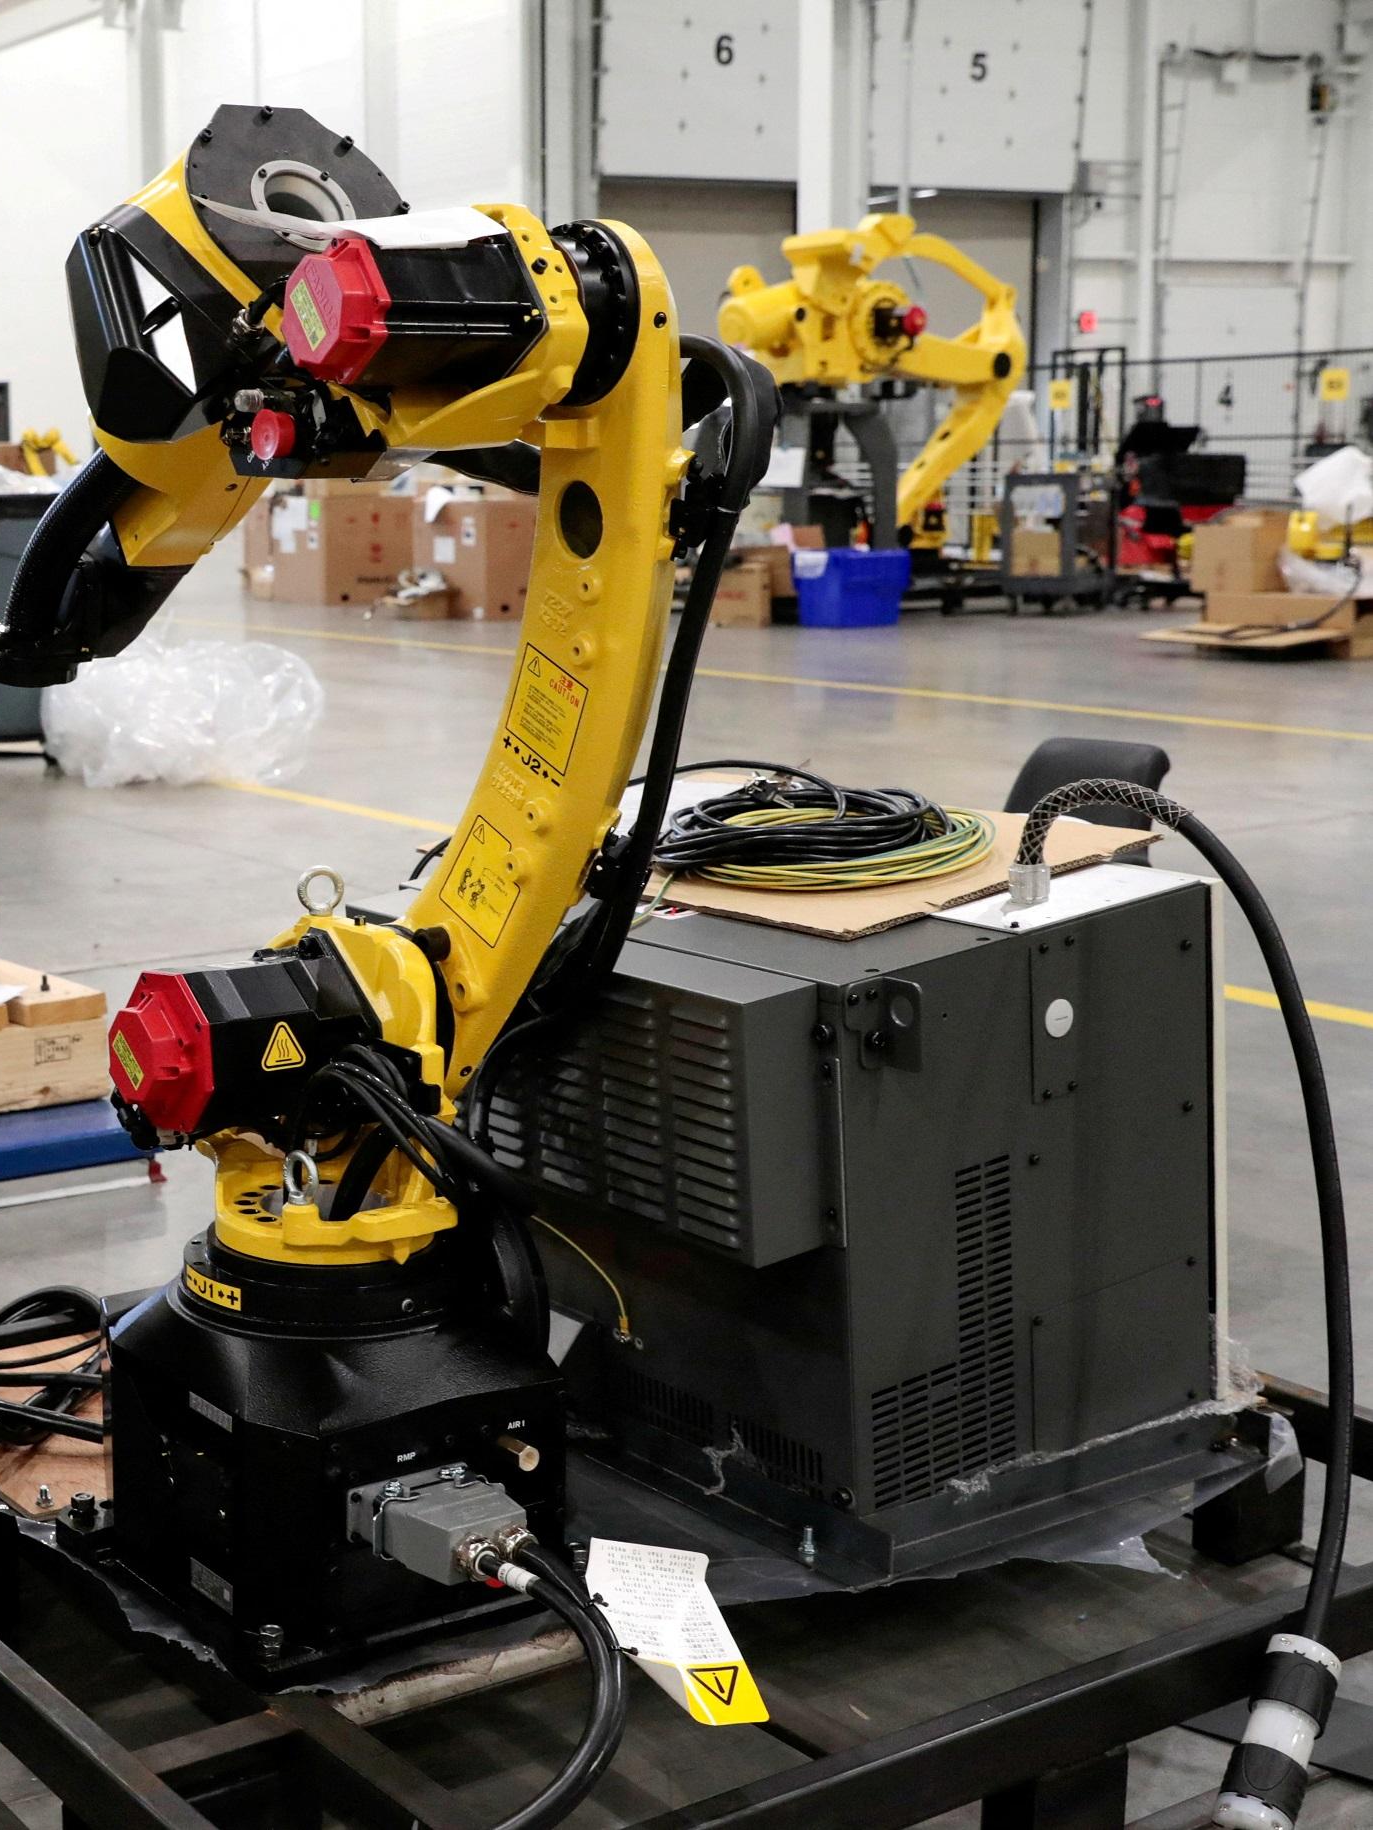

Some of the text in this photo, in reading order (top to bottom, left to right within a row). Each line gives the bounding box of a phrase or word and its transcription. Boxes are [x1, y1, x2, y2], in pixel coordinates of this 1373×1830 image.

[714, 35, 735, 65] 6
[970, 53, 987, 81] 5
[1217, 382, 1234, 408] 4
[549, 678, 580, 709] CAUTION
[521, 754, 541, 775] J2
[397, 1452, 416, 1463] RMP
